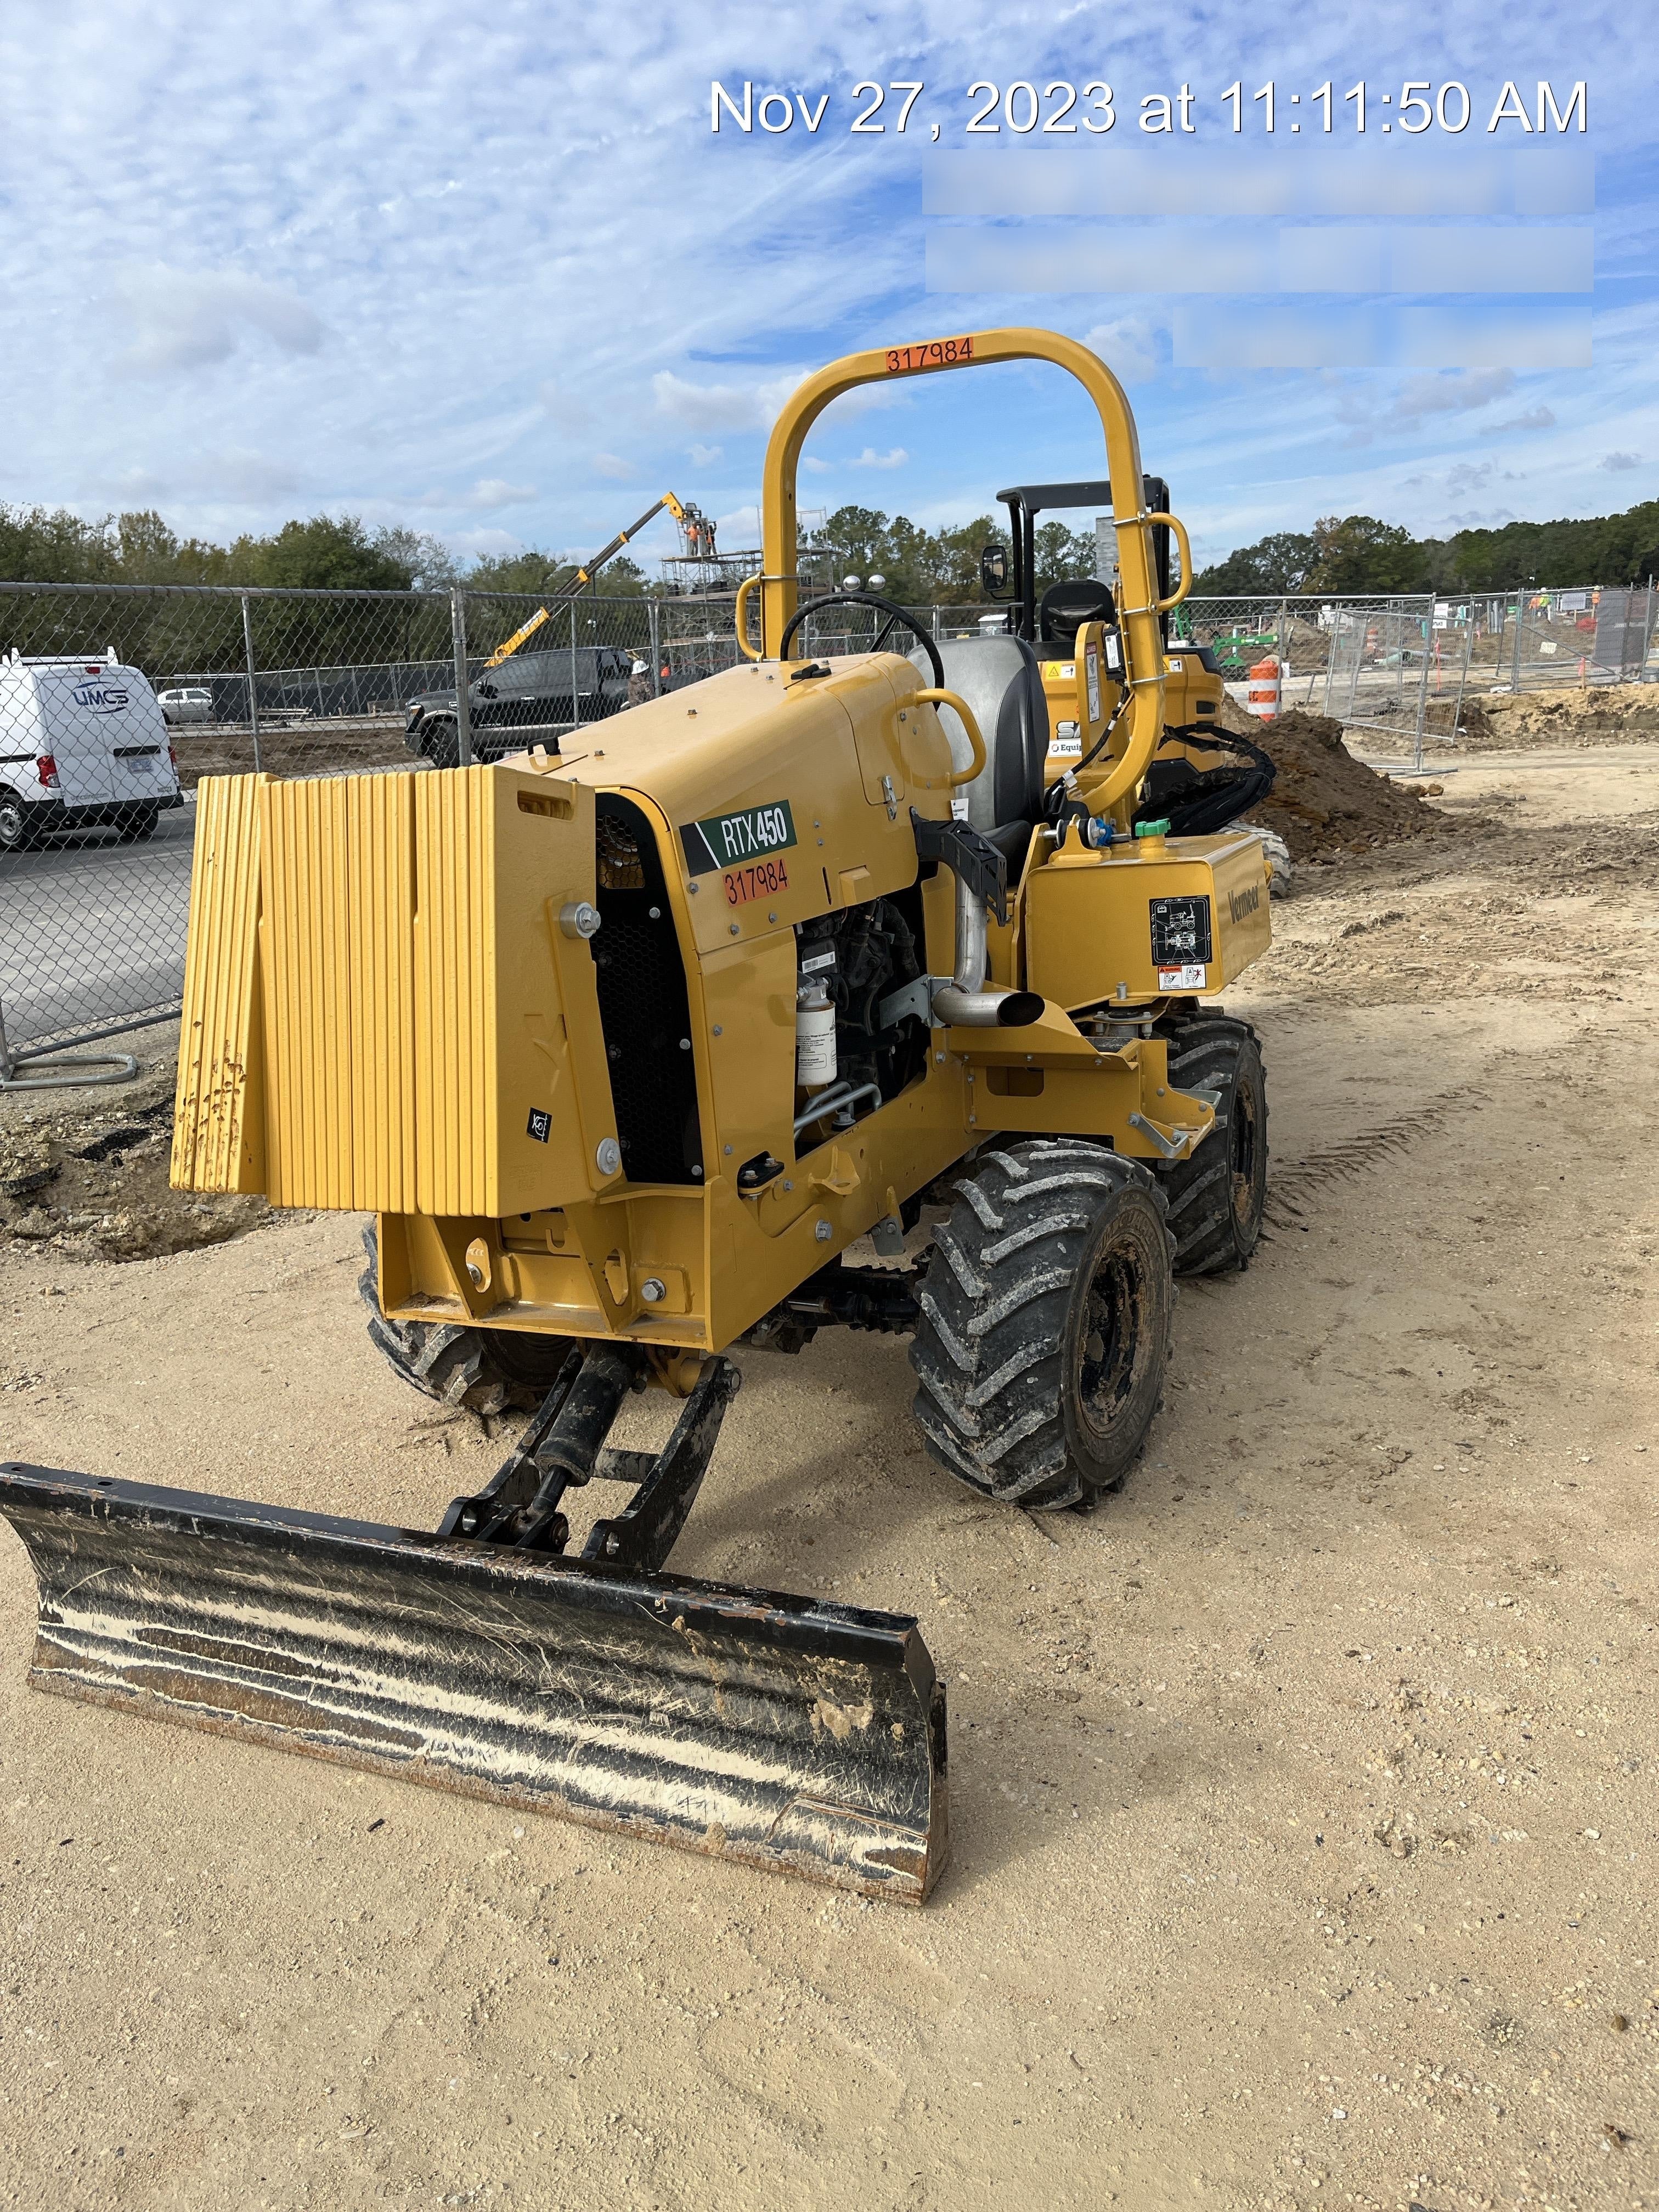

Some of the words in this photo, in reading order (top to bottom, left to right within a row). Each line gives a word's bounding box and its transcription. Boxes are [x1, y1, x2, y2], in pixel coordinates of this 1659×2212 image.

[888, 337, 973, 371] 317984
[72, 690, 129, 706] UMCS
[721, 808, 787, 857] RTX450
[725, 859, 787, 905] 317984
[1227, 885, 1259, 924] Vermeer
